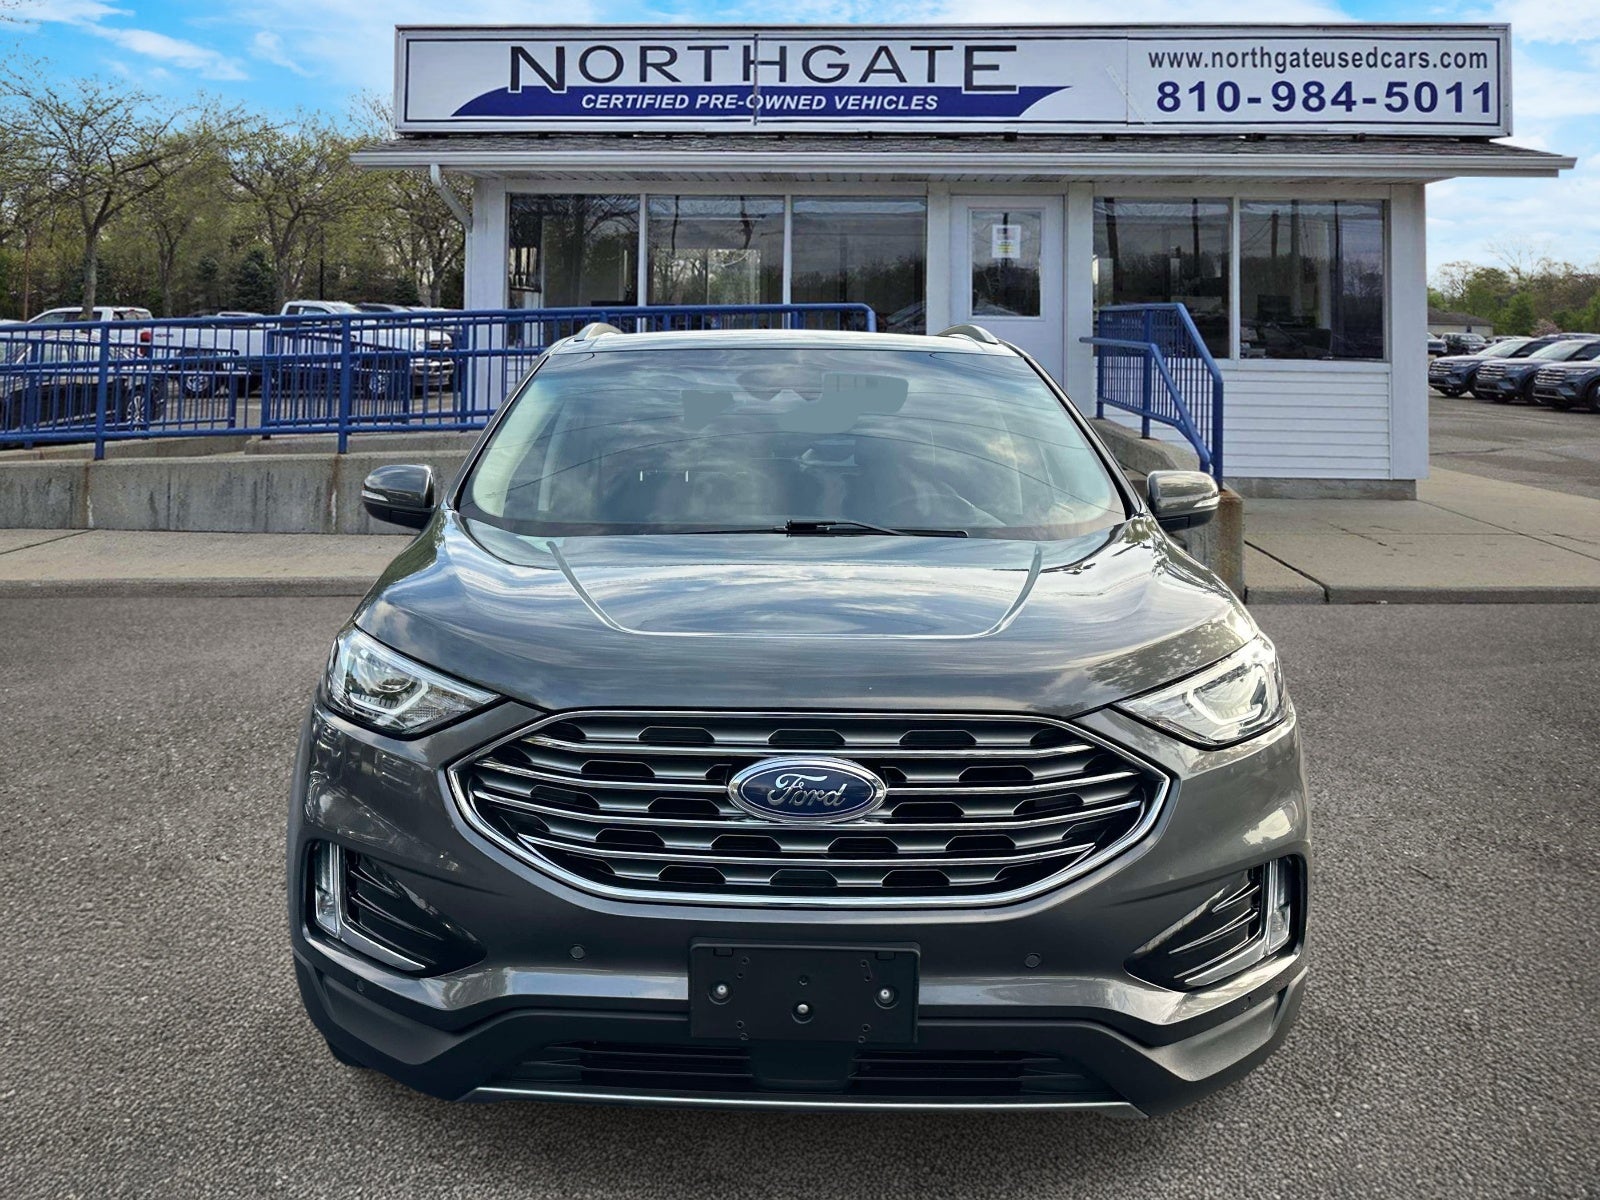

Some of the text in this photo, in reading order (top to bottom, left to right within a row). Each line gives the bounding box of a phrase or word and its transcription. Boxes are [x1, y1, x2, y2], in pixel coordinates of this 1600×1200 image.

[510, 44, 1018, 92] NORTHGATE
[1148, 46, 1489, 73] www.northgateusedcars.com
[581, 93, 939, 111] CERTIFIED PRE-OWNED VEHICLES
[1156, 80, 1491, 113] 810-984-5011
[766, 772, 848, 807] Ford
